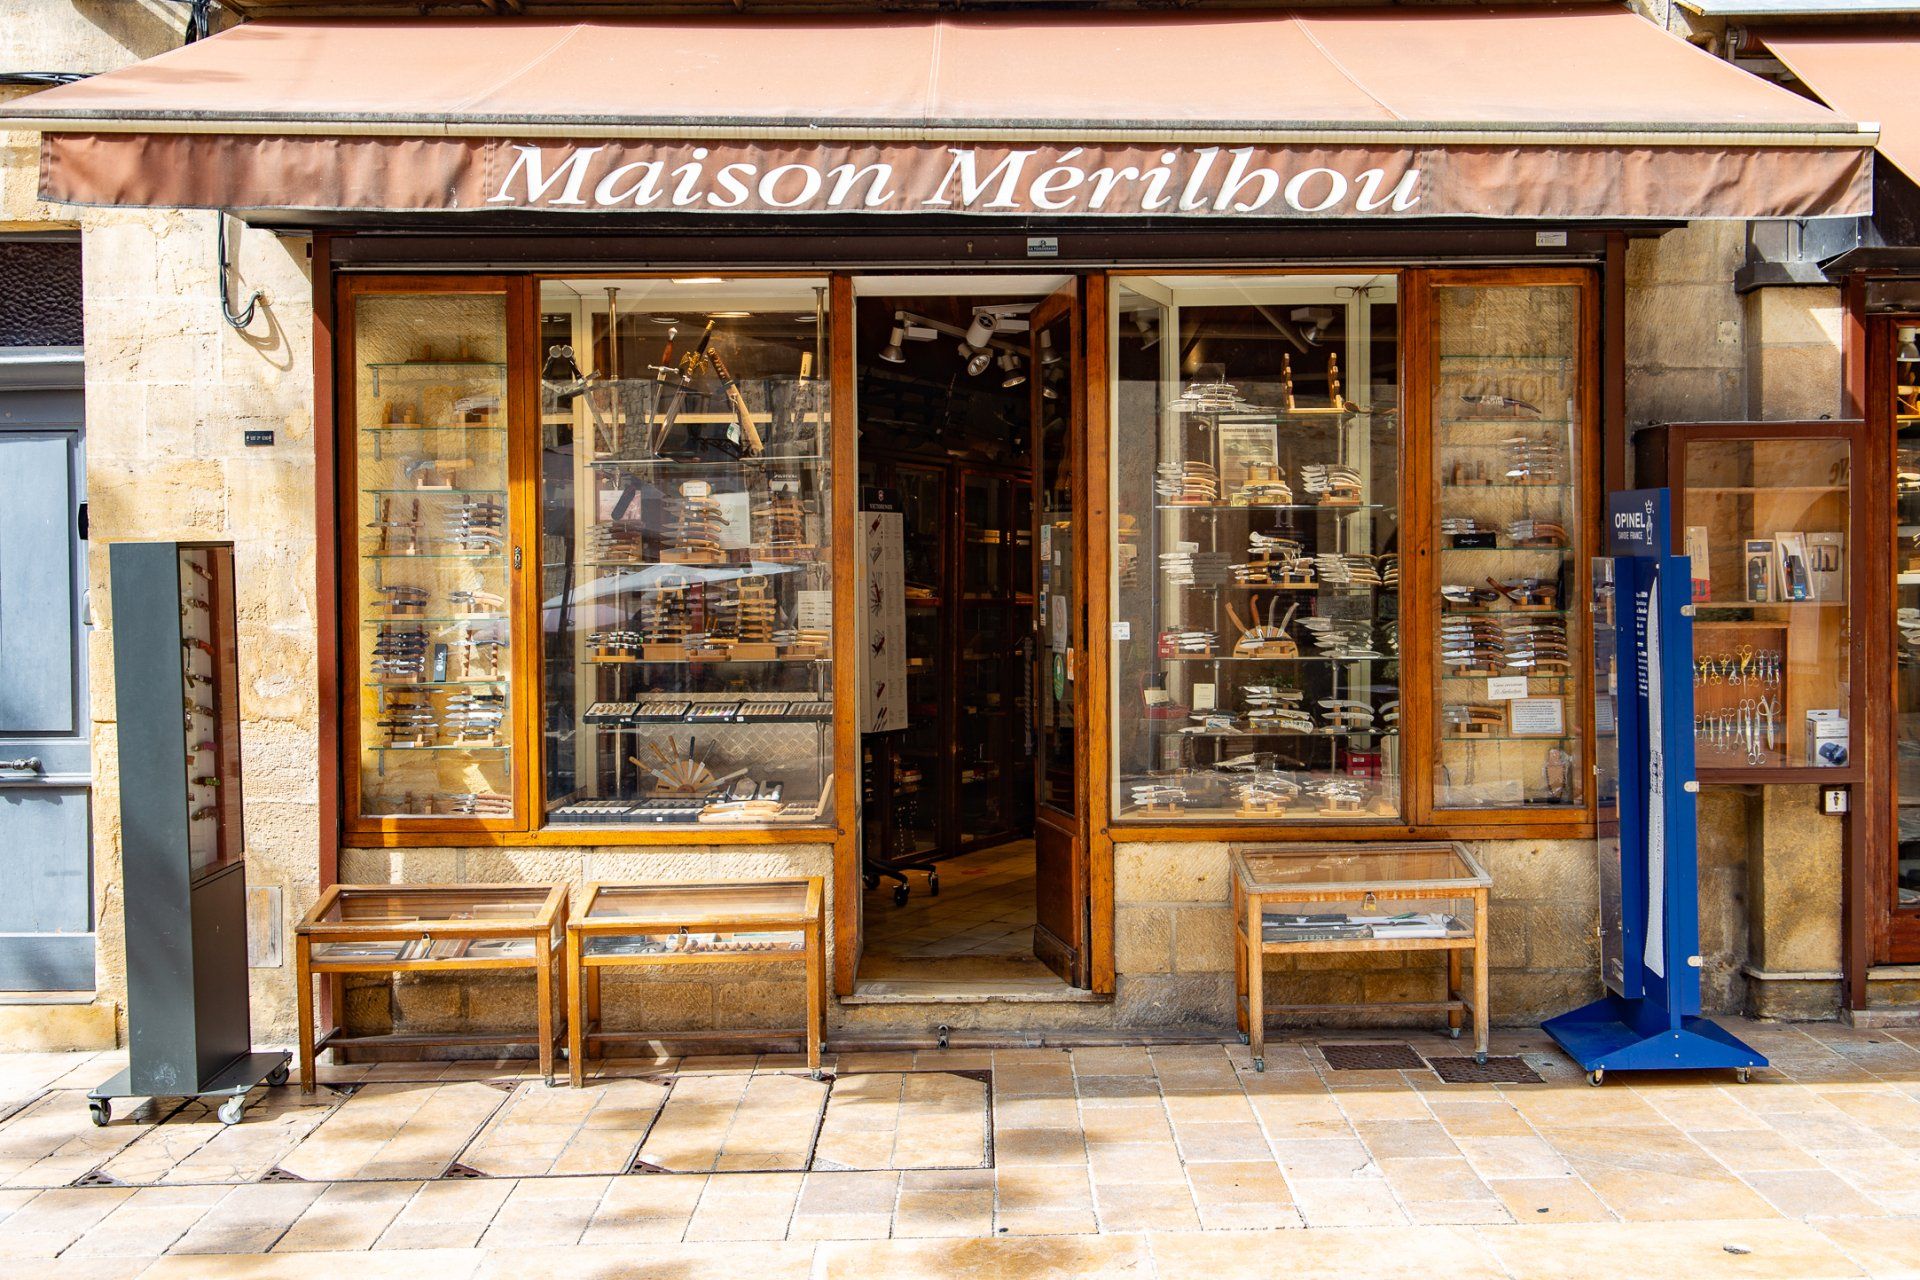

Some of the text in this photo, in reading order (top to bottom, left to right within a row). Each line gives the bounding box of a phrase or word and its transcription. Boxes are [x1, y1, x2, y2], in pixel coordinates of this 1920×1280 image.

[486, 144, 1421, 213] Maison Mérilhou
[1615, 512, 1646, 528] OPINEL
